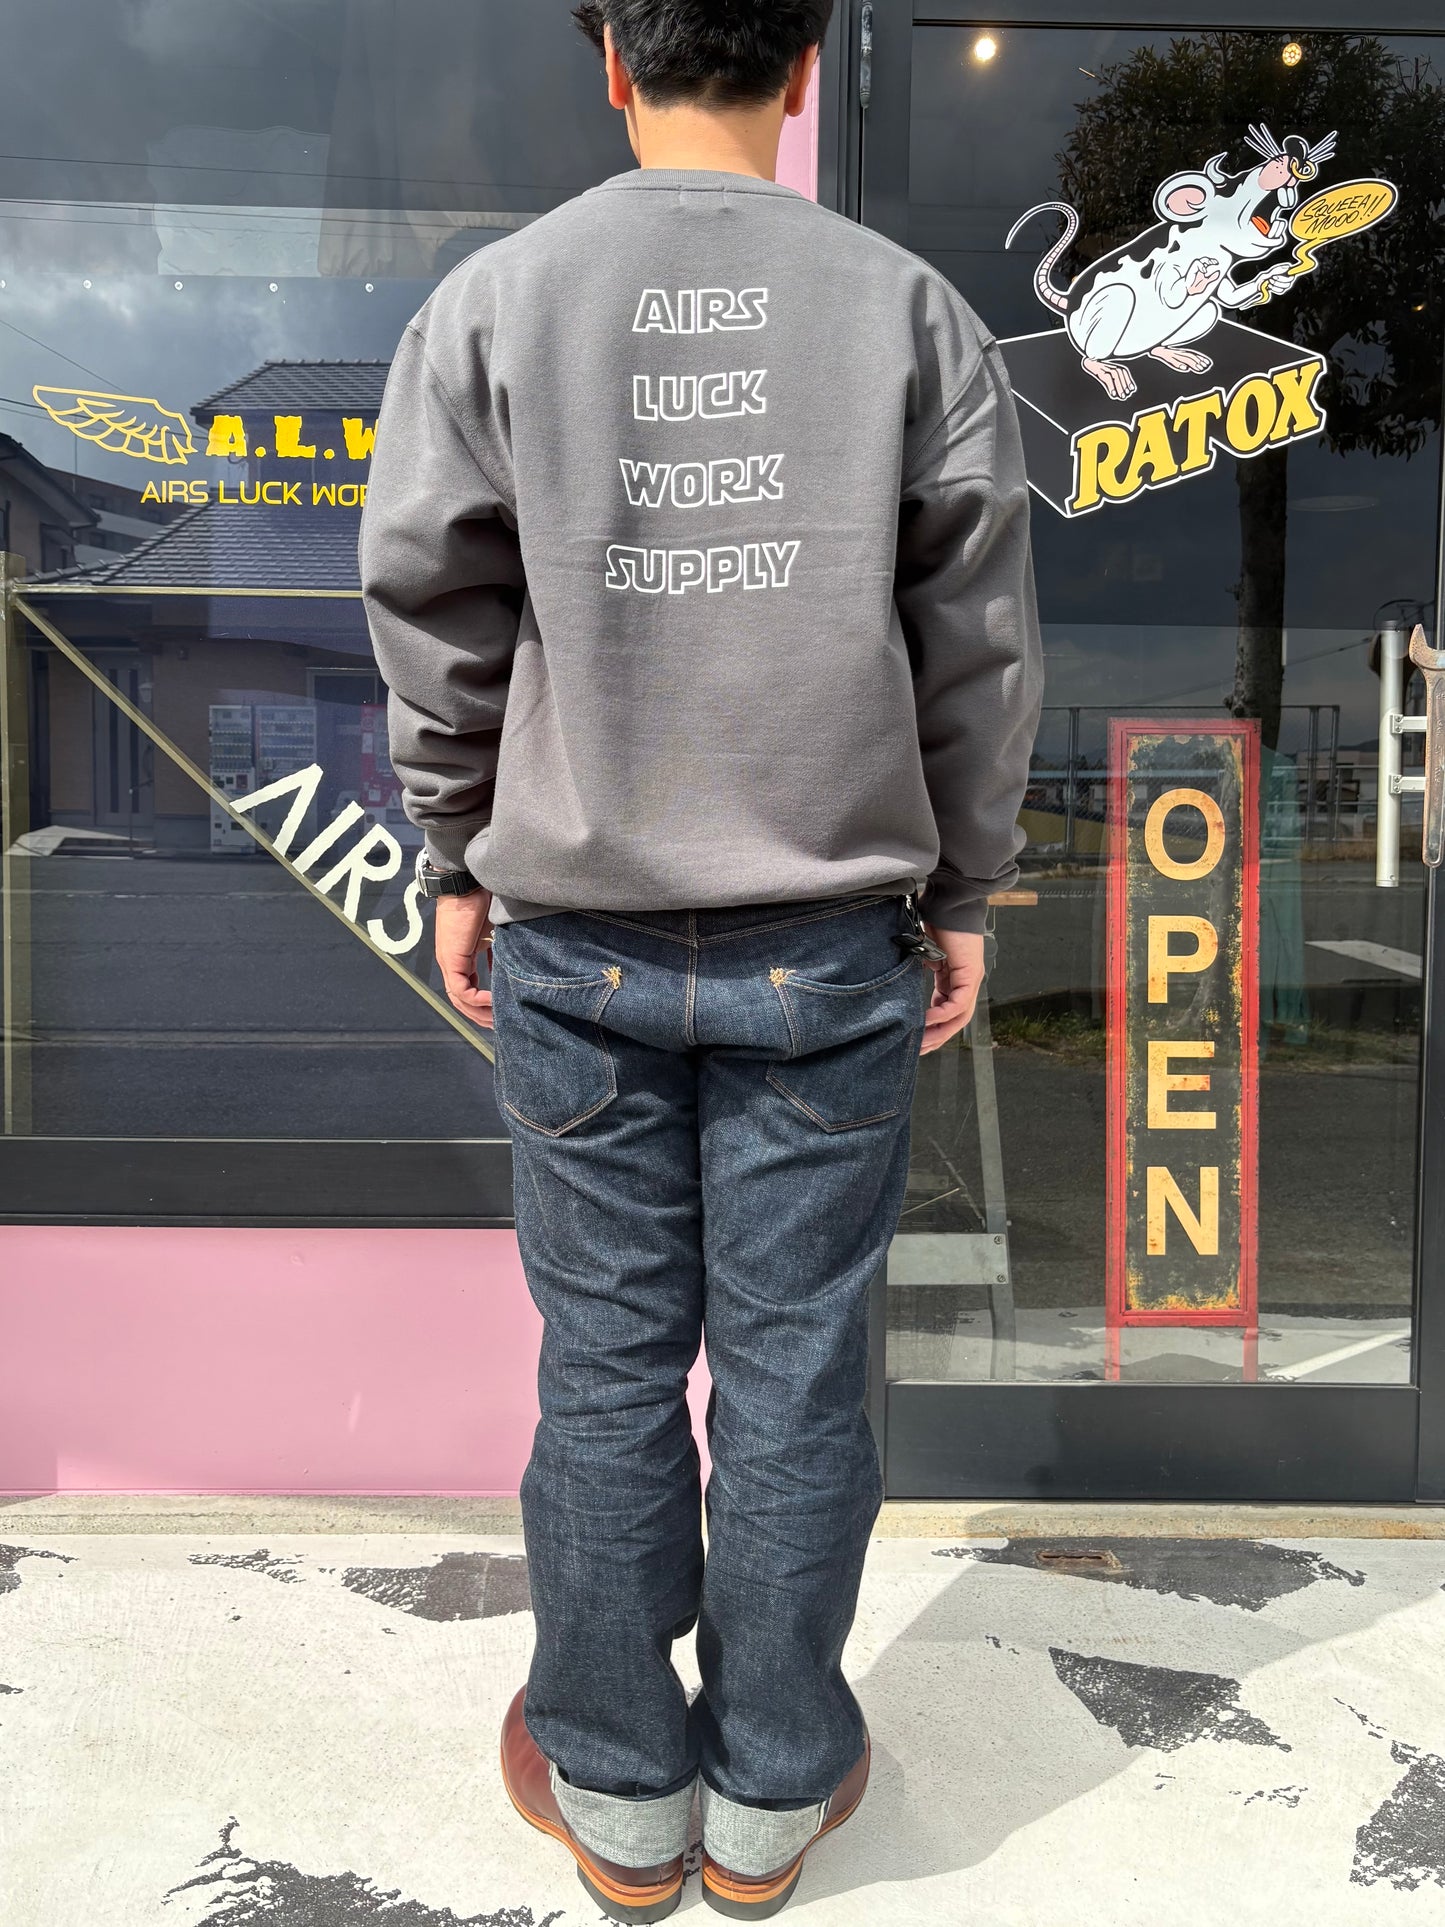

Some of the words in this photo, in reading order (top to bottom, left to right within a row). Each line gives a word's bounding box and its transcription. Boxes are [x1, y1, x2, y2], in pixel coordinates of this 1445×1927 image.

[632, 288, 768, 334] AIRS
[633, 369, 767, 421] LUCK
[1073, 362, 1322, 511] RATOX
[141, 480, 209, 503] AIRS
[218, 480, 302, 506] LUCK
[312, 482, 368, 508] WO
[619, 454, 784, 508] WORK
[605, 541, 801, 594] SUPPLY
[230, 763, 424, 954] AIRS
[1144, 788, 1225, 1256] OPEN
